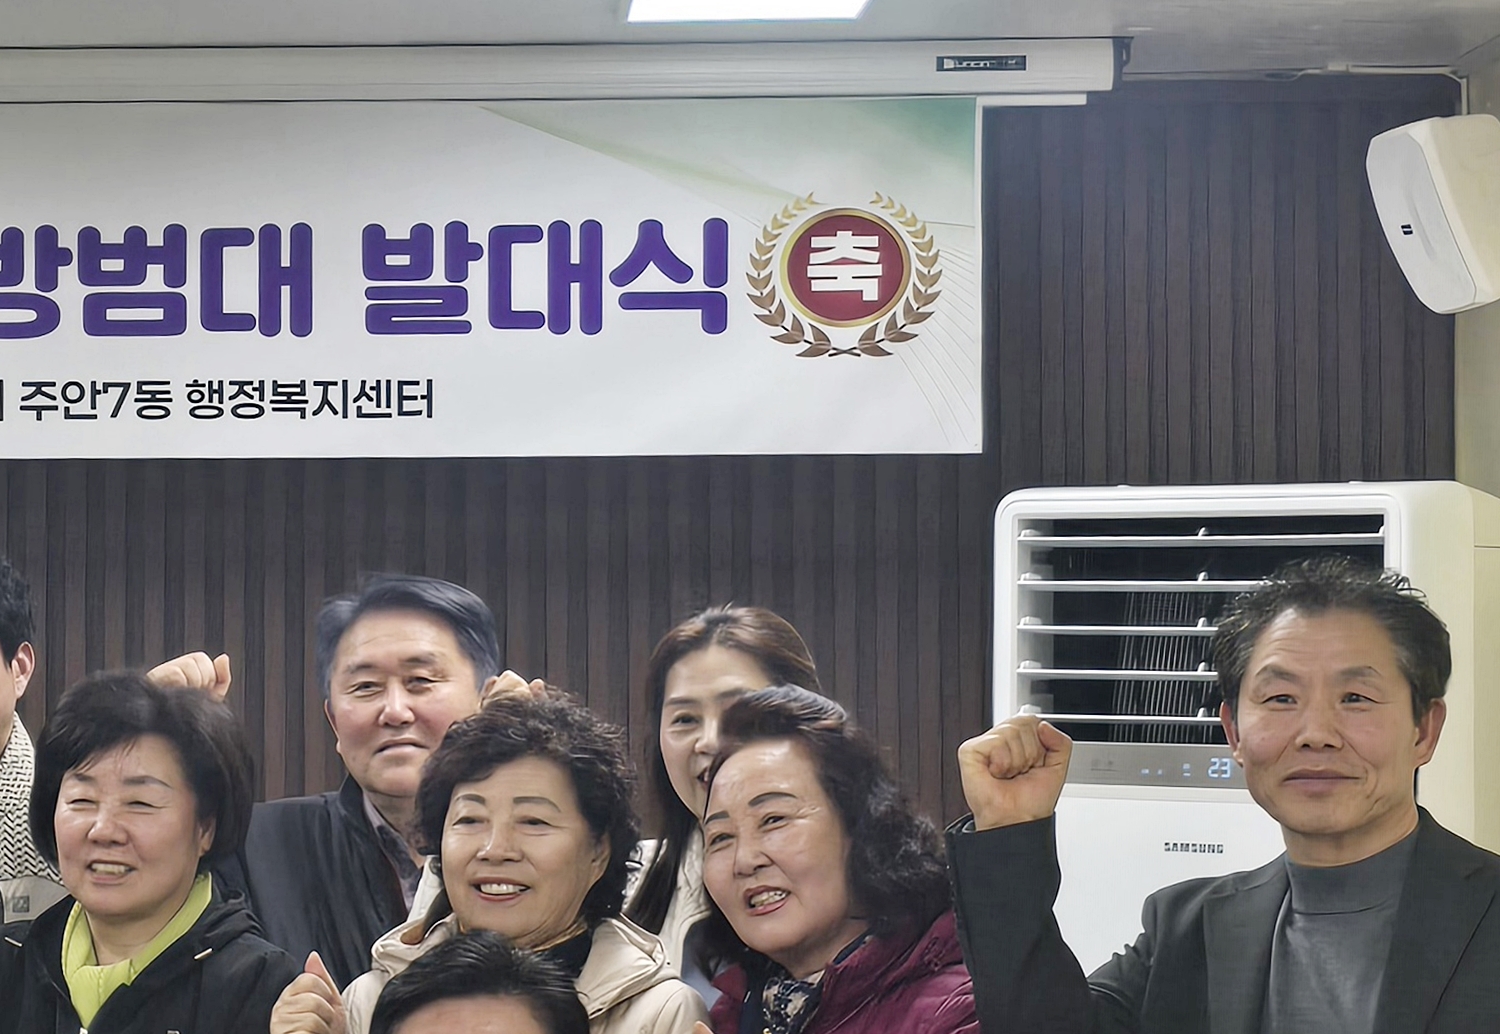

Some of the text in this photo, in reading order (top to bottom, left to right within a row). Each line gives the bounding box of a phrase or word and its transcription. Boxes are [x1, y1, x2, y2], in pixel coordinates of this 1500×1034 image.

[361, 217, 729, 336] 발대식
[806, 229, 883, 301] 축
[19, 379, 174, 422] 주안7동
[185, 378, 433, 420] 행정복지센터
[1208, 757, 1231, 778] 23
[1164, 842, 1224, 854] SAMSUNG
